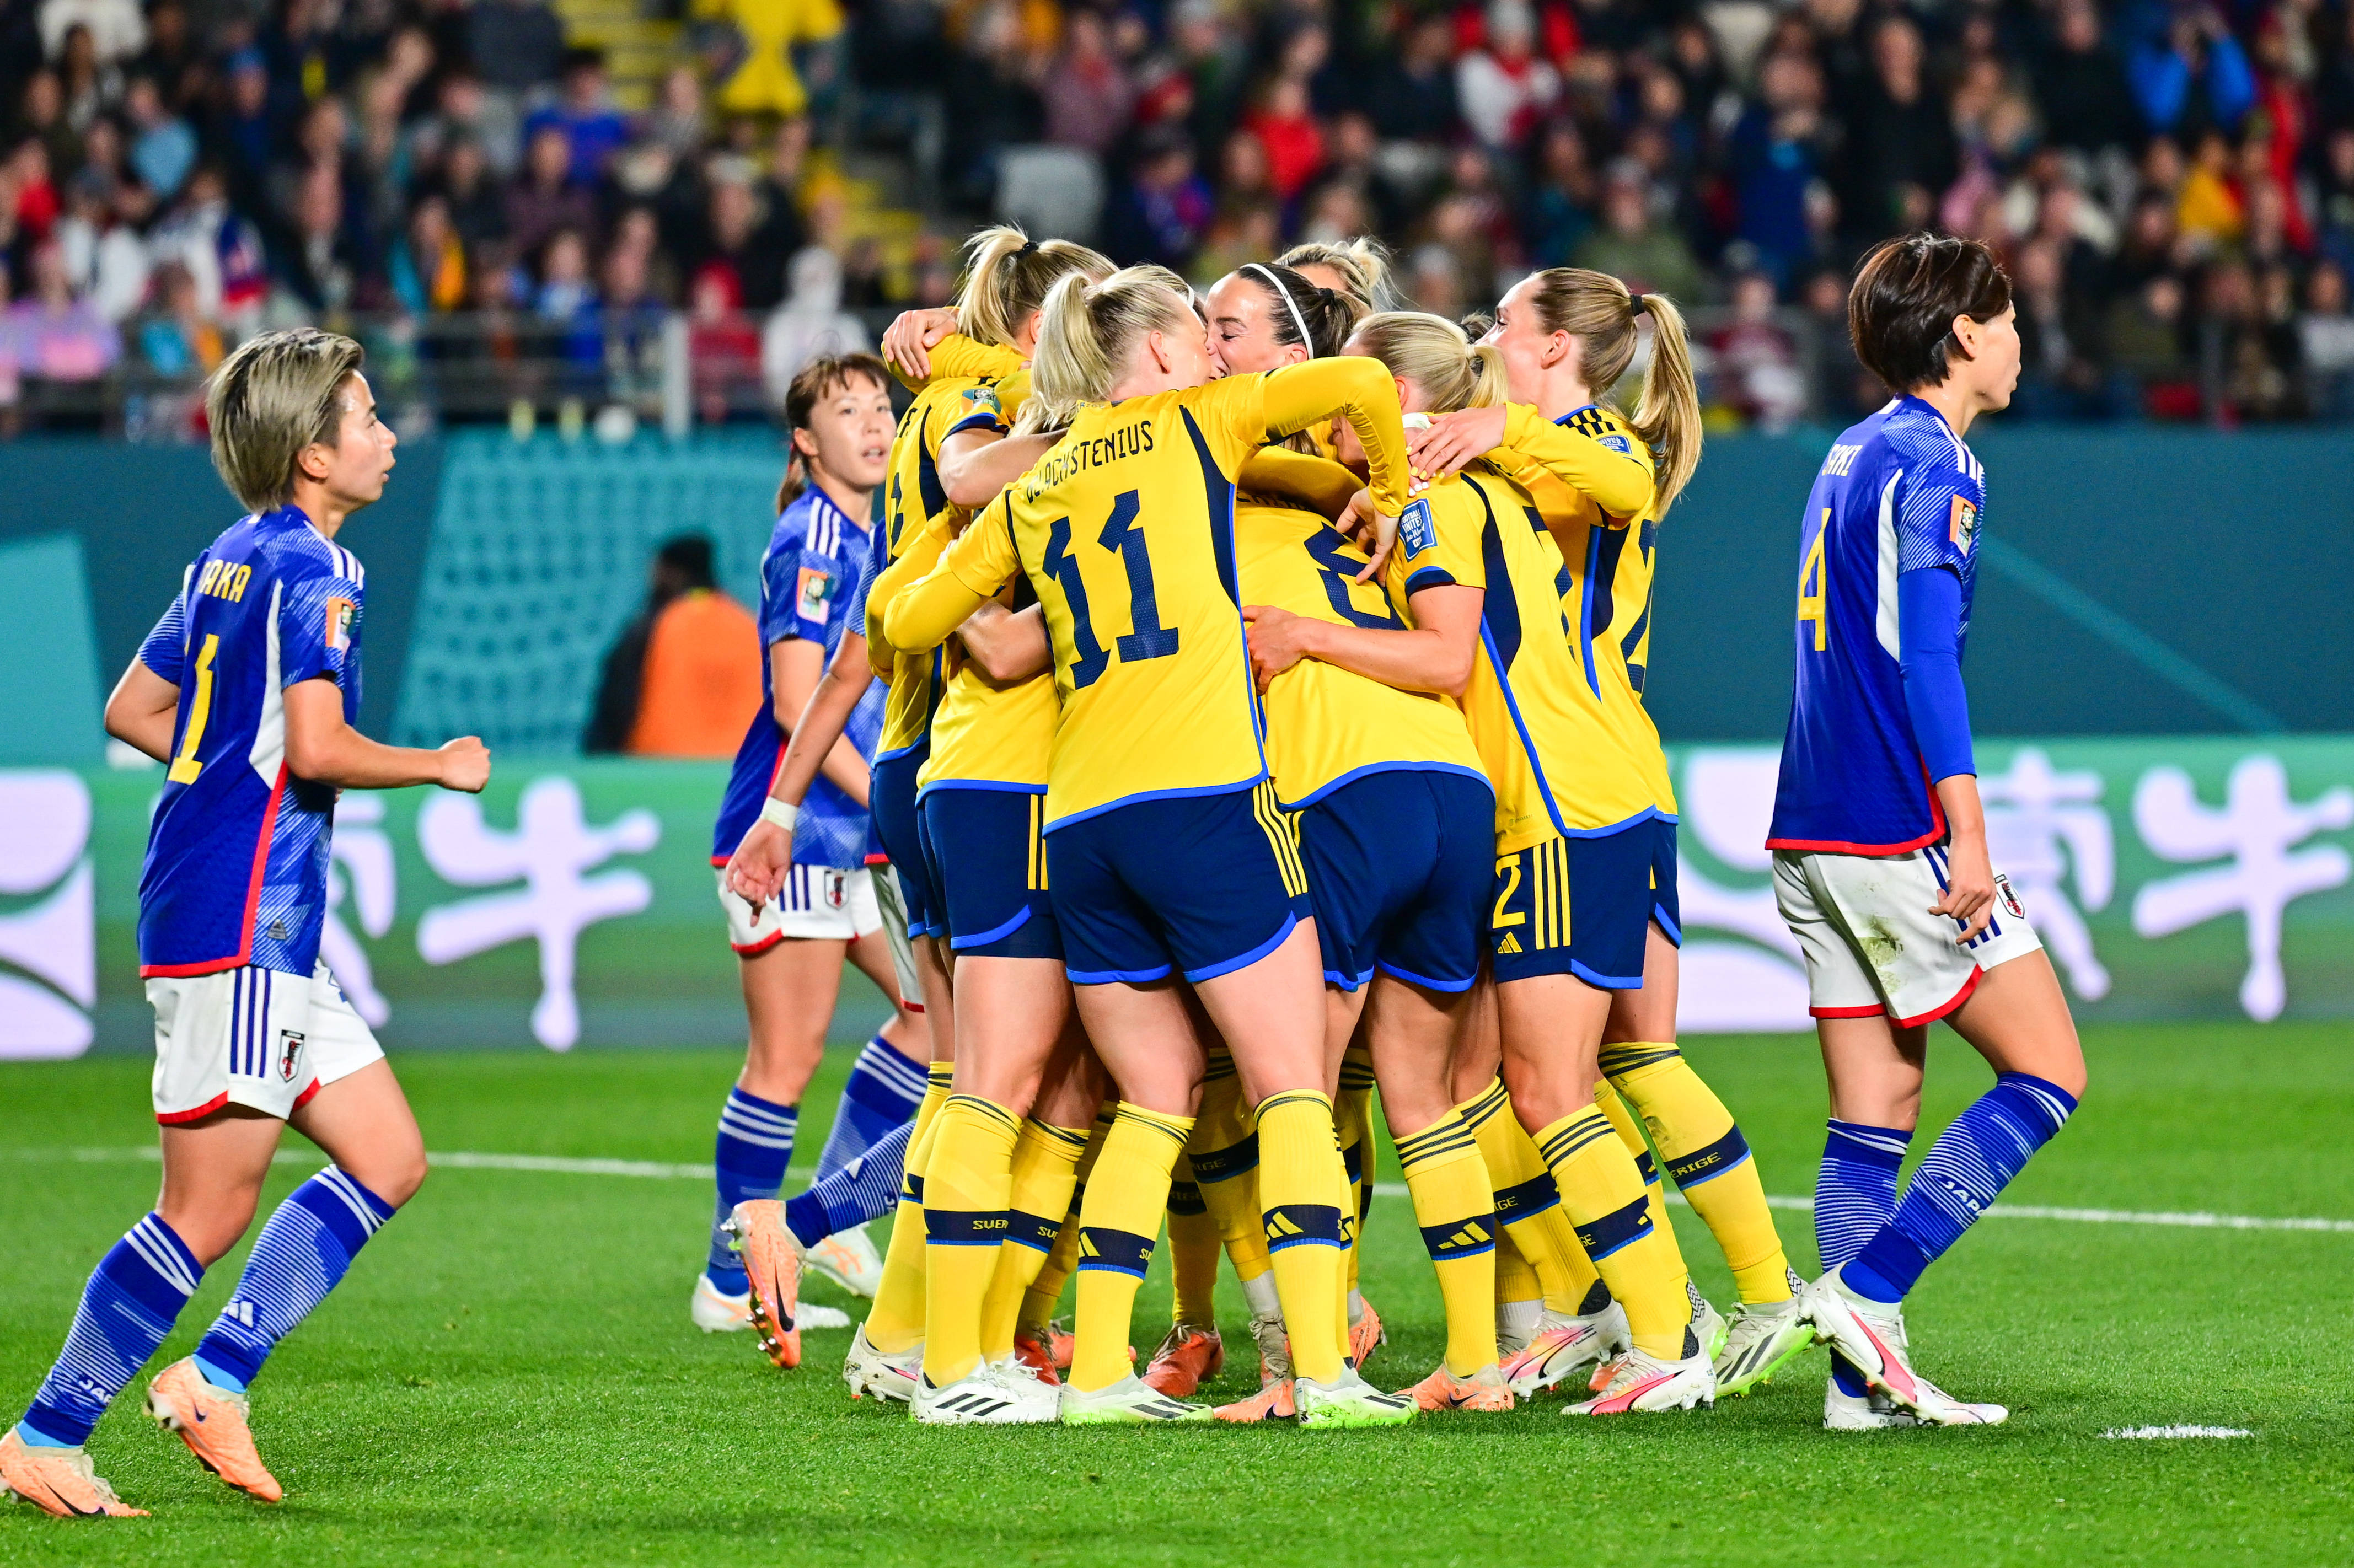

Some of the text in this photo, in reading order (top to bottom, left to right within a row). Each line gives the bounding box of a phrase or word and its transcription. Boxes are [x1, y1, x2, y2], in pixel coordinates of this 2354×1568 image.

[1042, 488, 1179, 690] 11
[1798, 508, 1832, 651] 4
[167, 633, 219, 785] 1
[1492, 854, 1526, 930] 2
